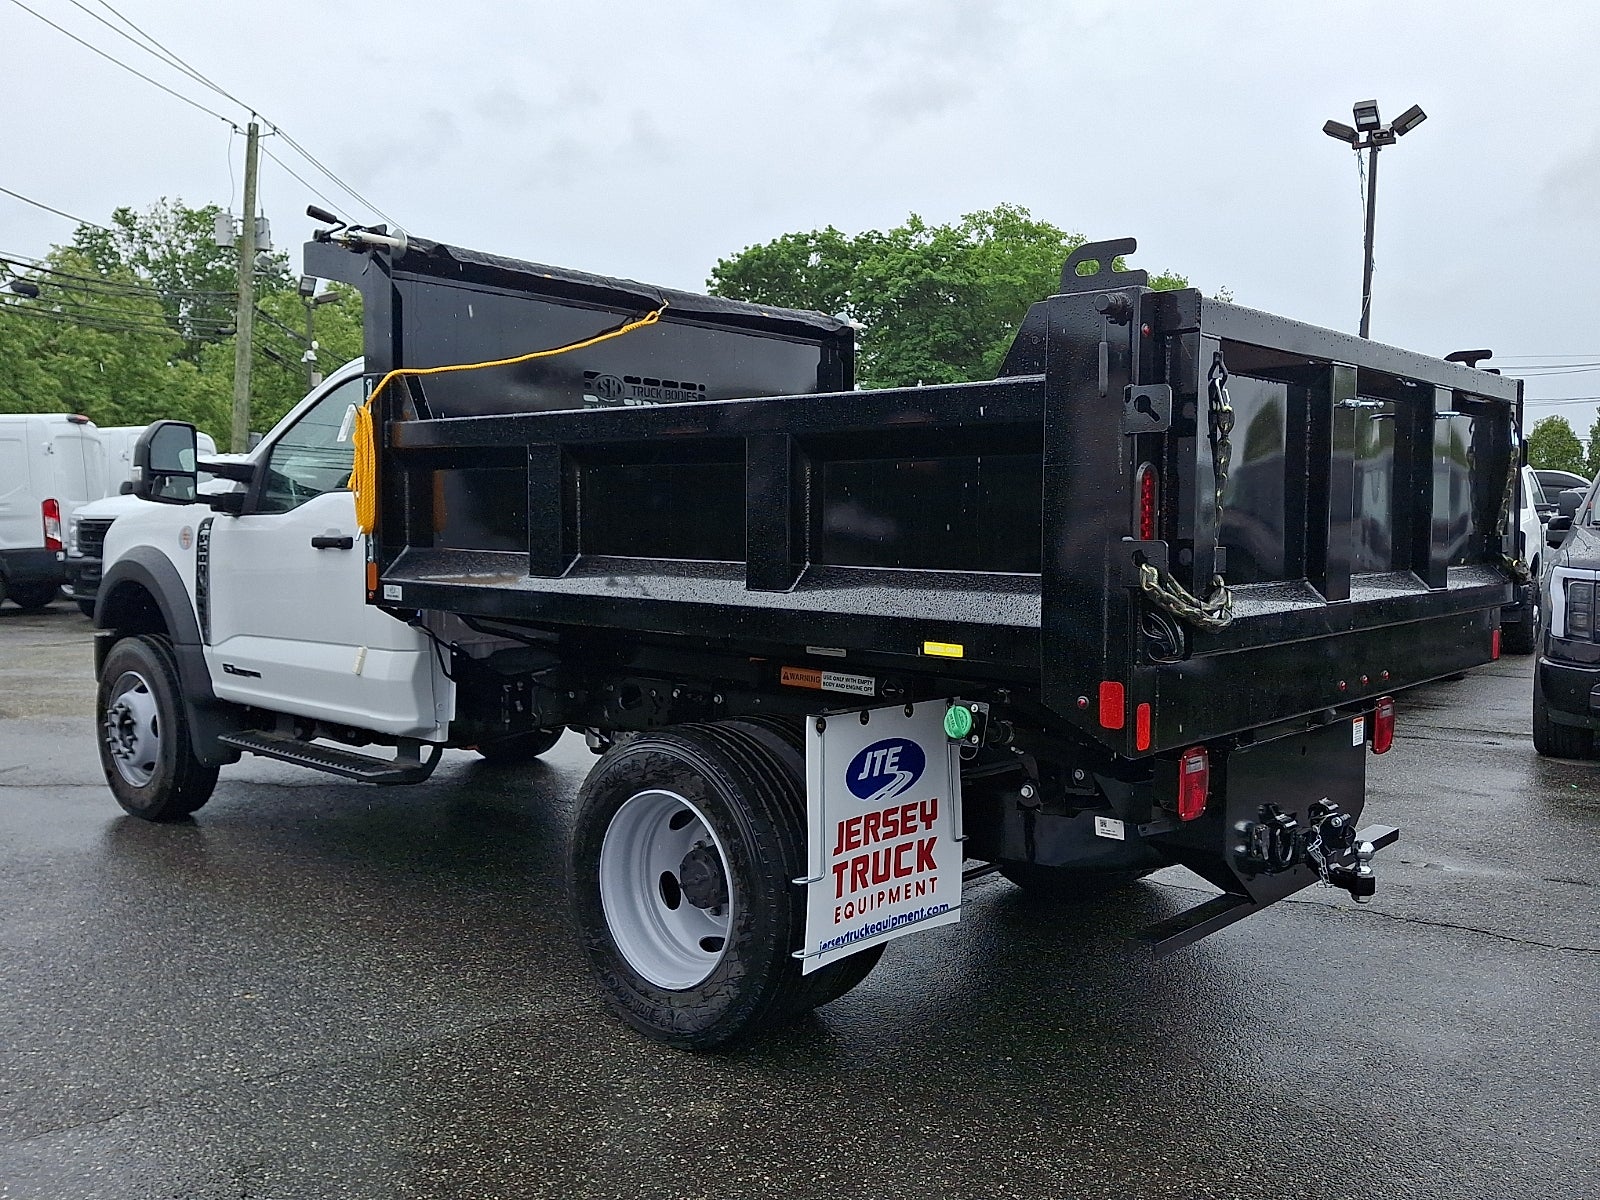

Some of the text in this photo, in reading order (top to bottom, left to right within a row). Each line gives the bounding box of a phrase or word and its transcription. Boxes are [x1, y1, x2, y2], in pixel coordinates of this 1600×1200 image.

[631, 385, 698, 402] TRUCK BODIES
[789, 672, 821, 684] WARNING
[833, 675, 845, 683] ONLY
[857, 678, 873, 686] EMPTY
[846, 684, 863, 692] ENGINE
[858, 746, 903, 781] JTE
[832, 798, 938, 856] JERSEY
[832, 836, 938, 899] TRUCK
[834, 877, 938, 925] EQUIPMENT
[818, 903, 949, 959] jerseytruckequipment.com
